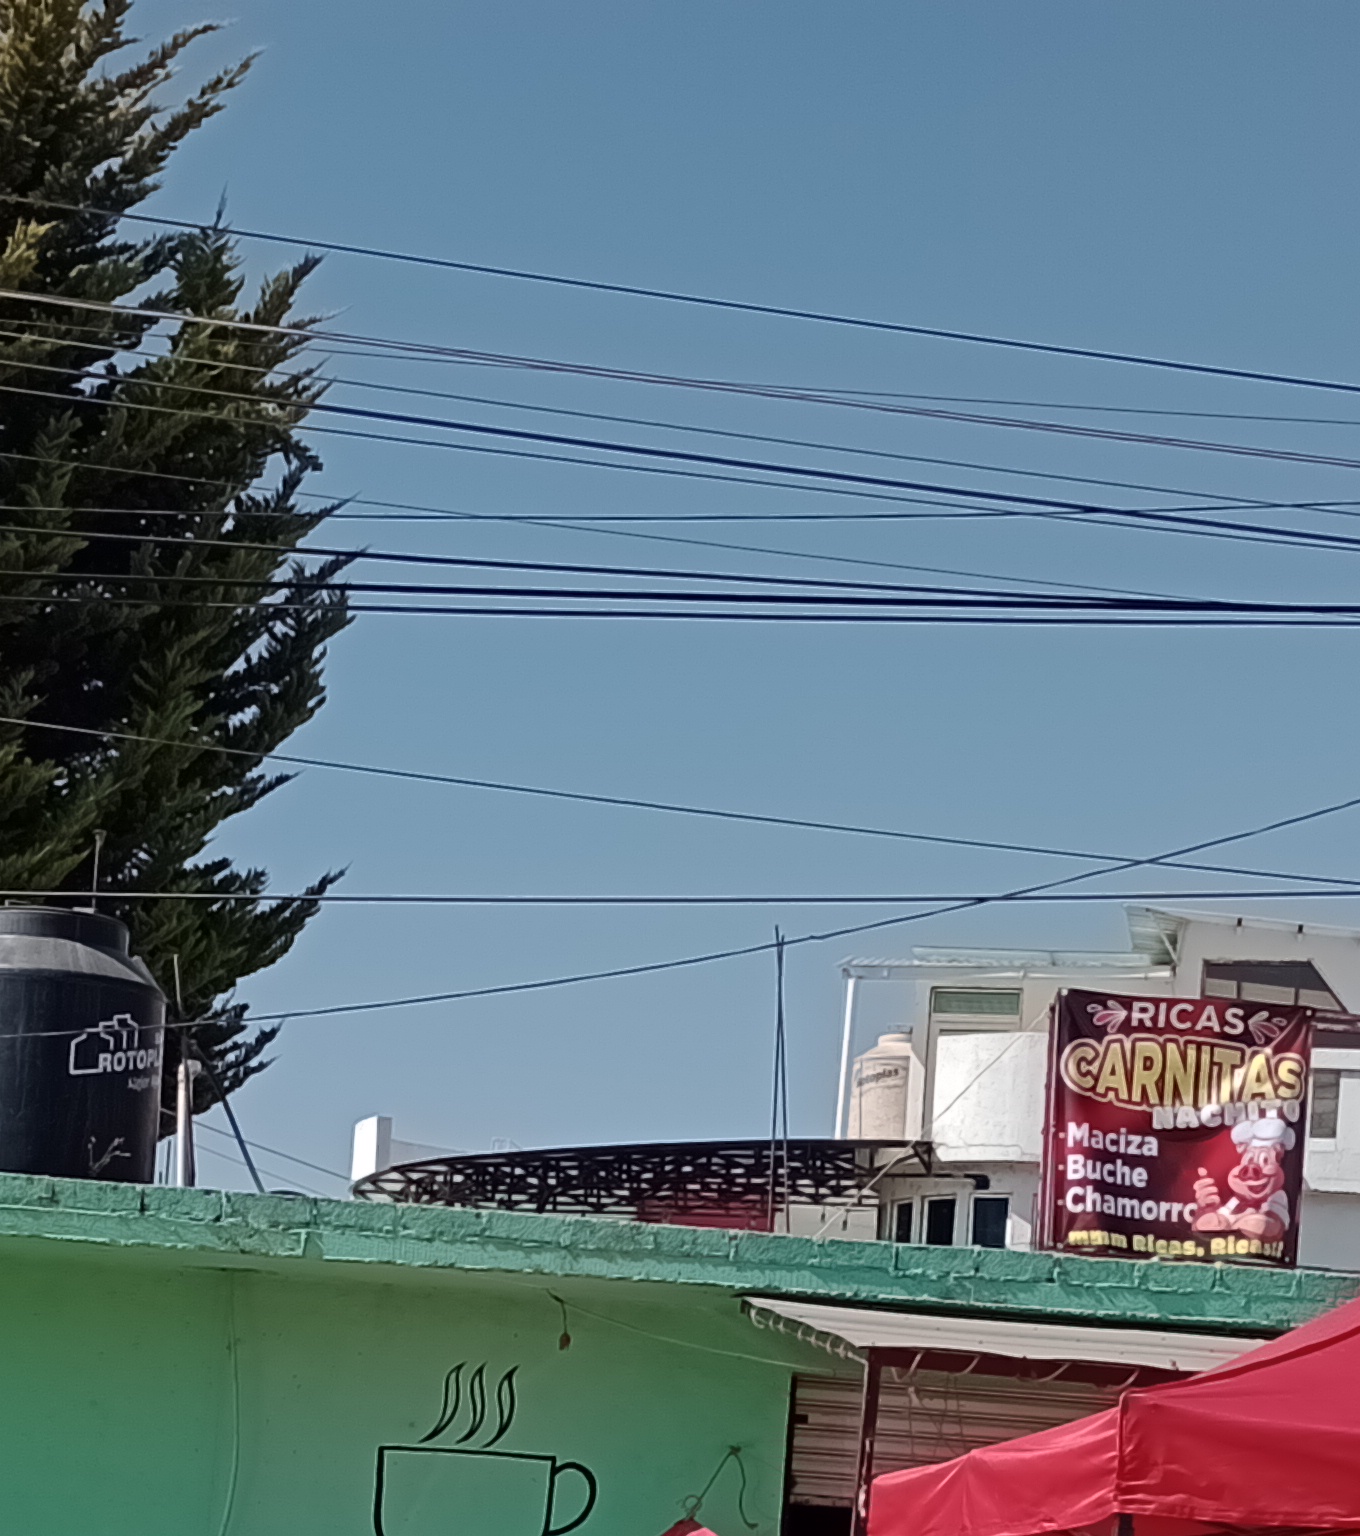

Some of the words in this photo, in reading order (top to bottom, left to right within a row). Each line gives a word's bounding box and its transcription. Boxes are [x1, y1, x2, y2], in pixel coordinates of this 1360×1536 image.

[1130, 1002, 1245, 1034] RICAS
[1064, 1038, 1304, 1109] CARNITAS
[1152, 1100, 1300, 1130] NACHITO
[1066, 1122, 1159, 1157] Maciza
[1066, 1154, 1149, 1188] Buche
